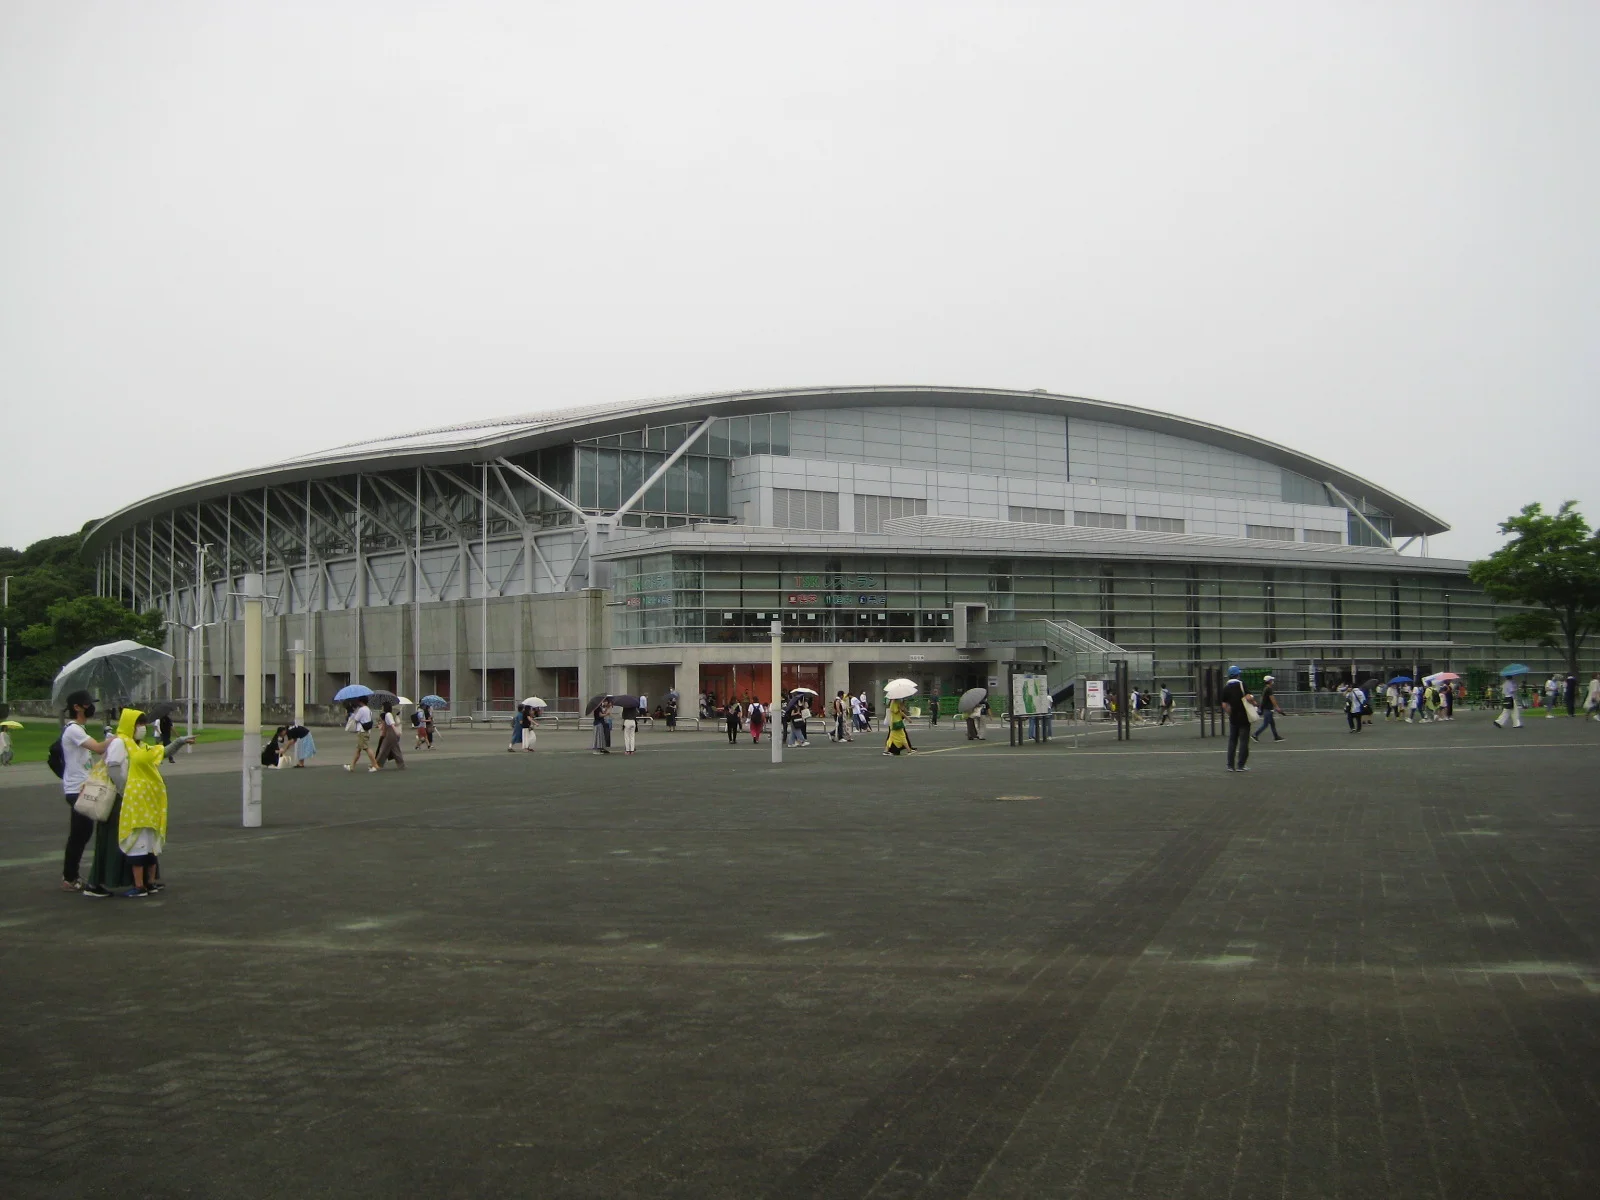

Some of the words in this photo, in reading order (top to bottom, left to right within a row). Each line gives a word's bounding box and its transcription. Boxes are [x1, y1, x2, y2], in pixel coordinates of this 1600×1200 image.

[794, 576, 819, 588] TSK
[823, 575, 878, 588] レストラン
